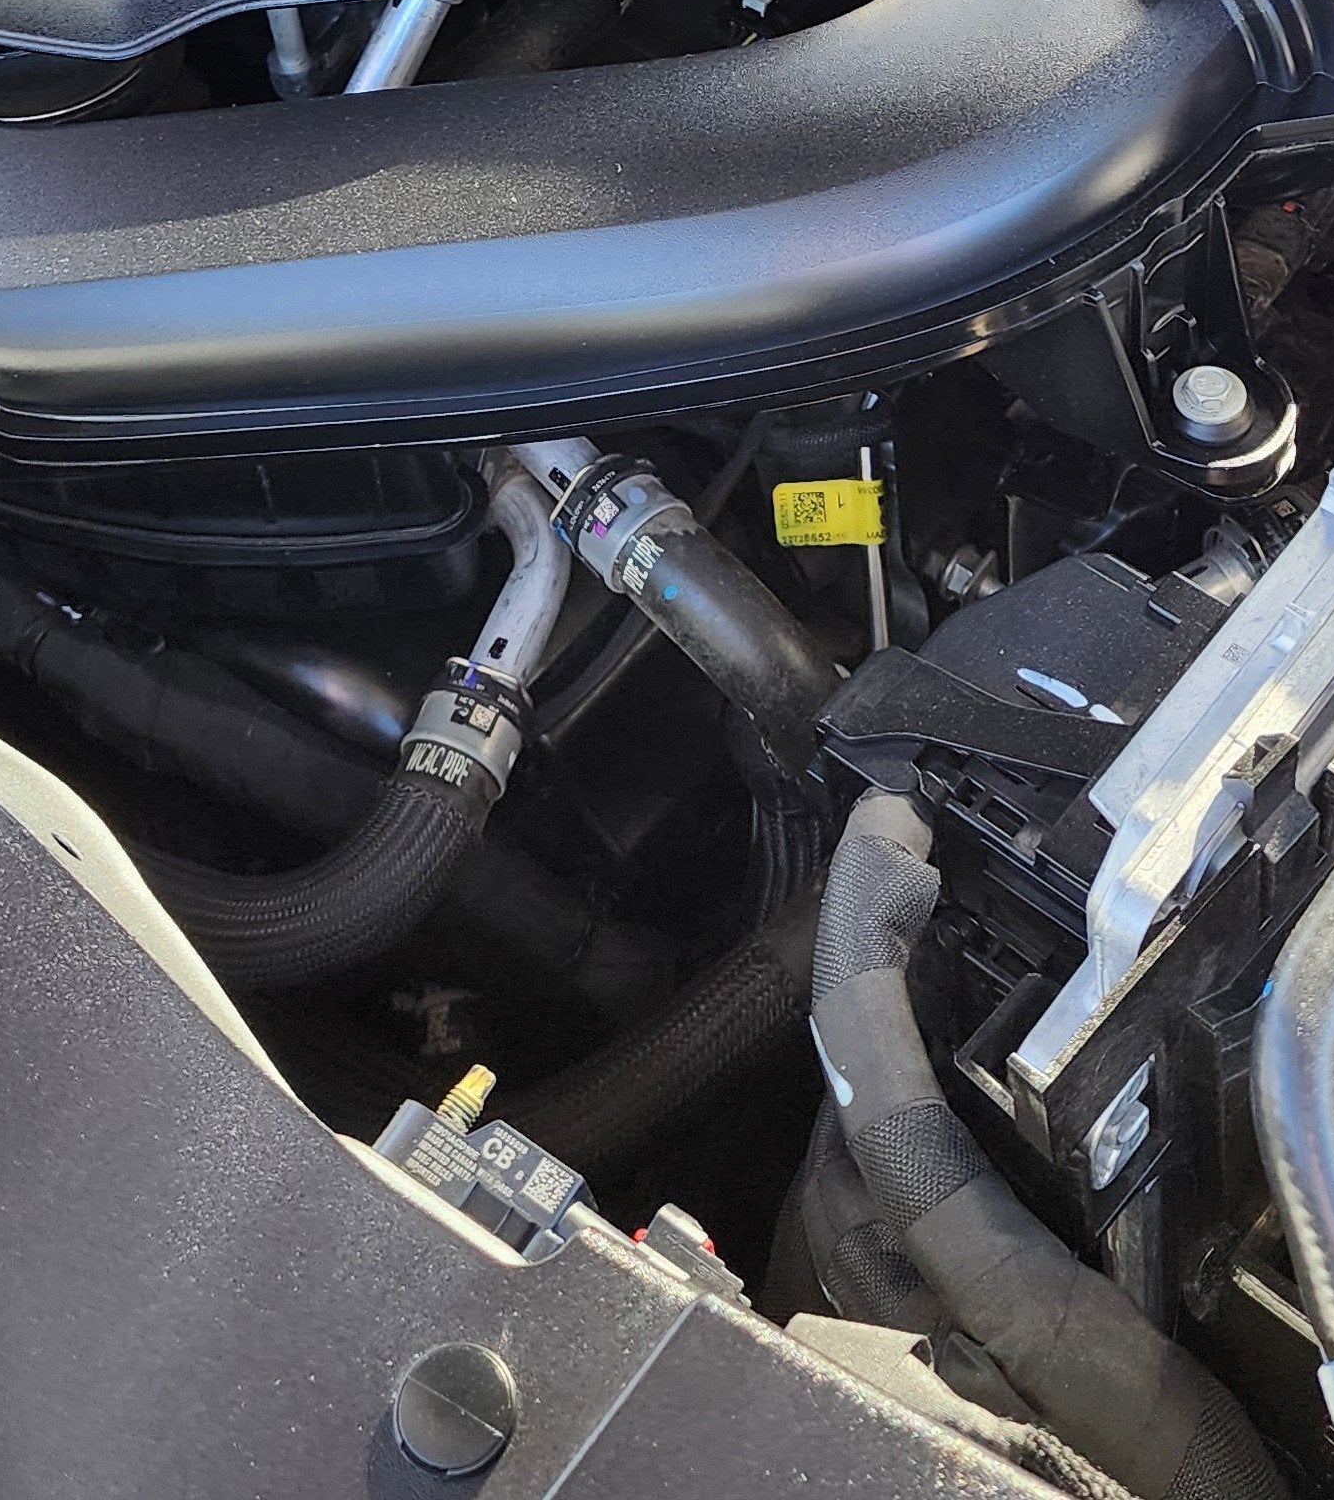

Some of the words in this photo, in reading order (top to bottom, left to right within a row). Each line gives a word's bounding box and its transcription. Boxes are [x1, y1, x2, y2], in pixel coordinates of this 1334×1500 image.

[632, 535, 665, 570] UPR
[622, 558, 649, 596] PIPE
[405, 742, 446, 776] WCAC
[438, 751, 474, 787] PIPE
[481, 1137, 515, 1170] CB
